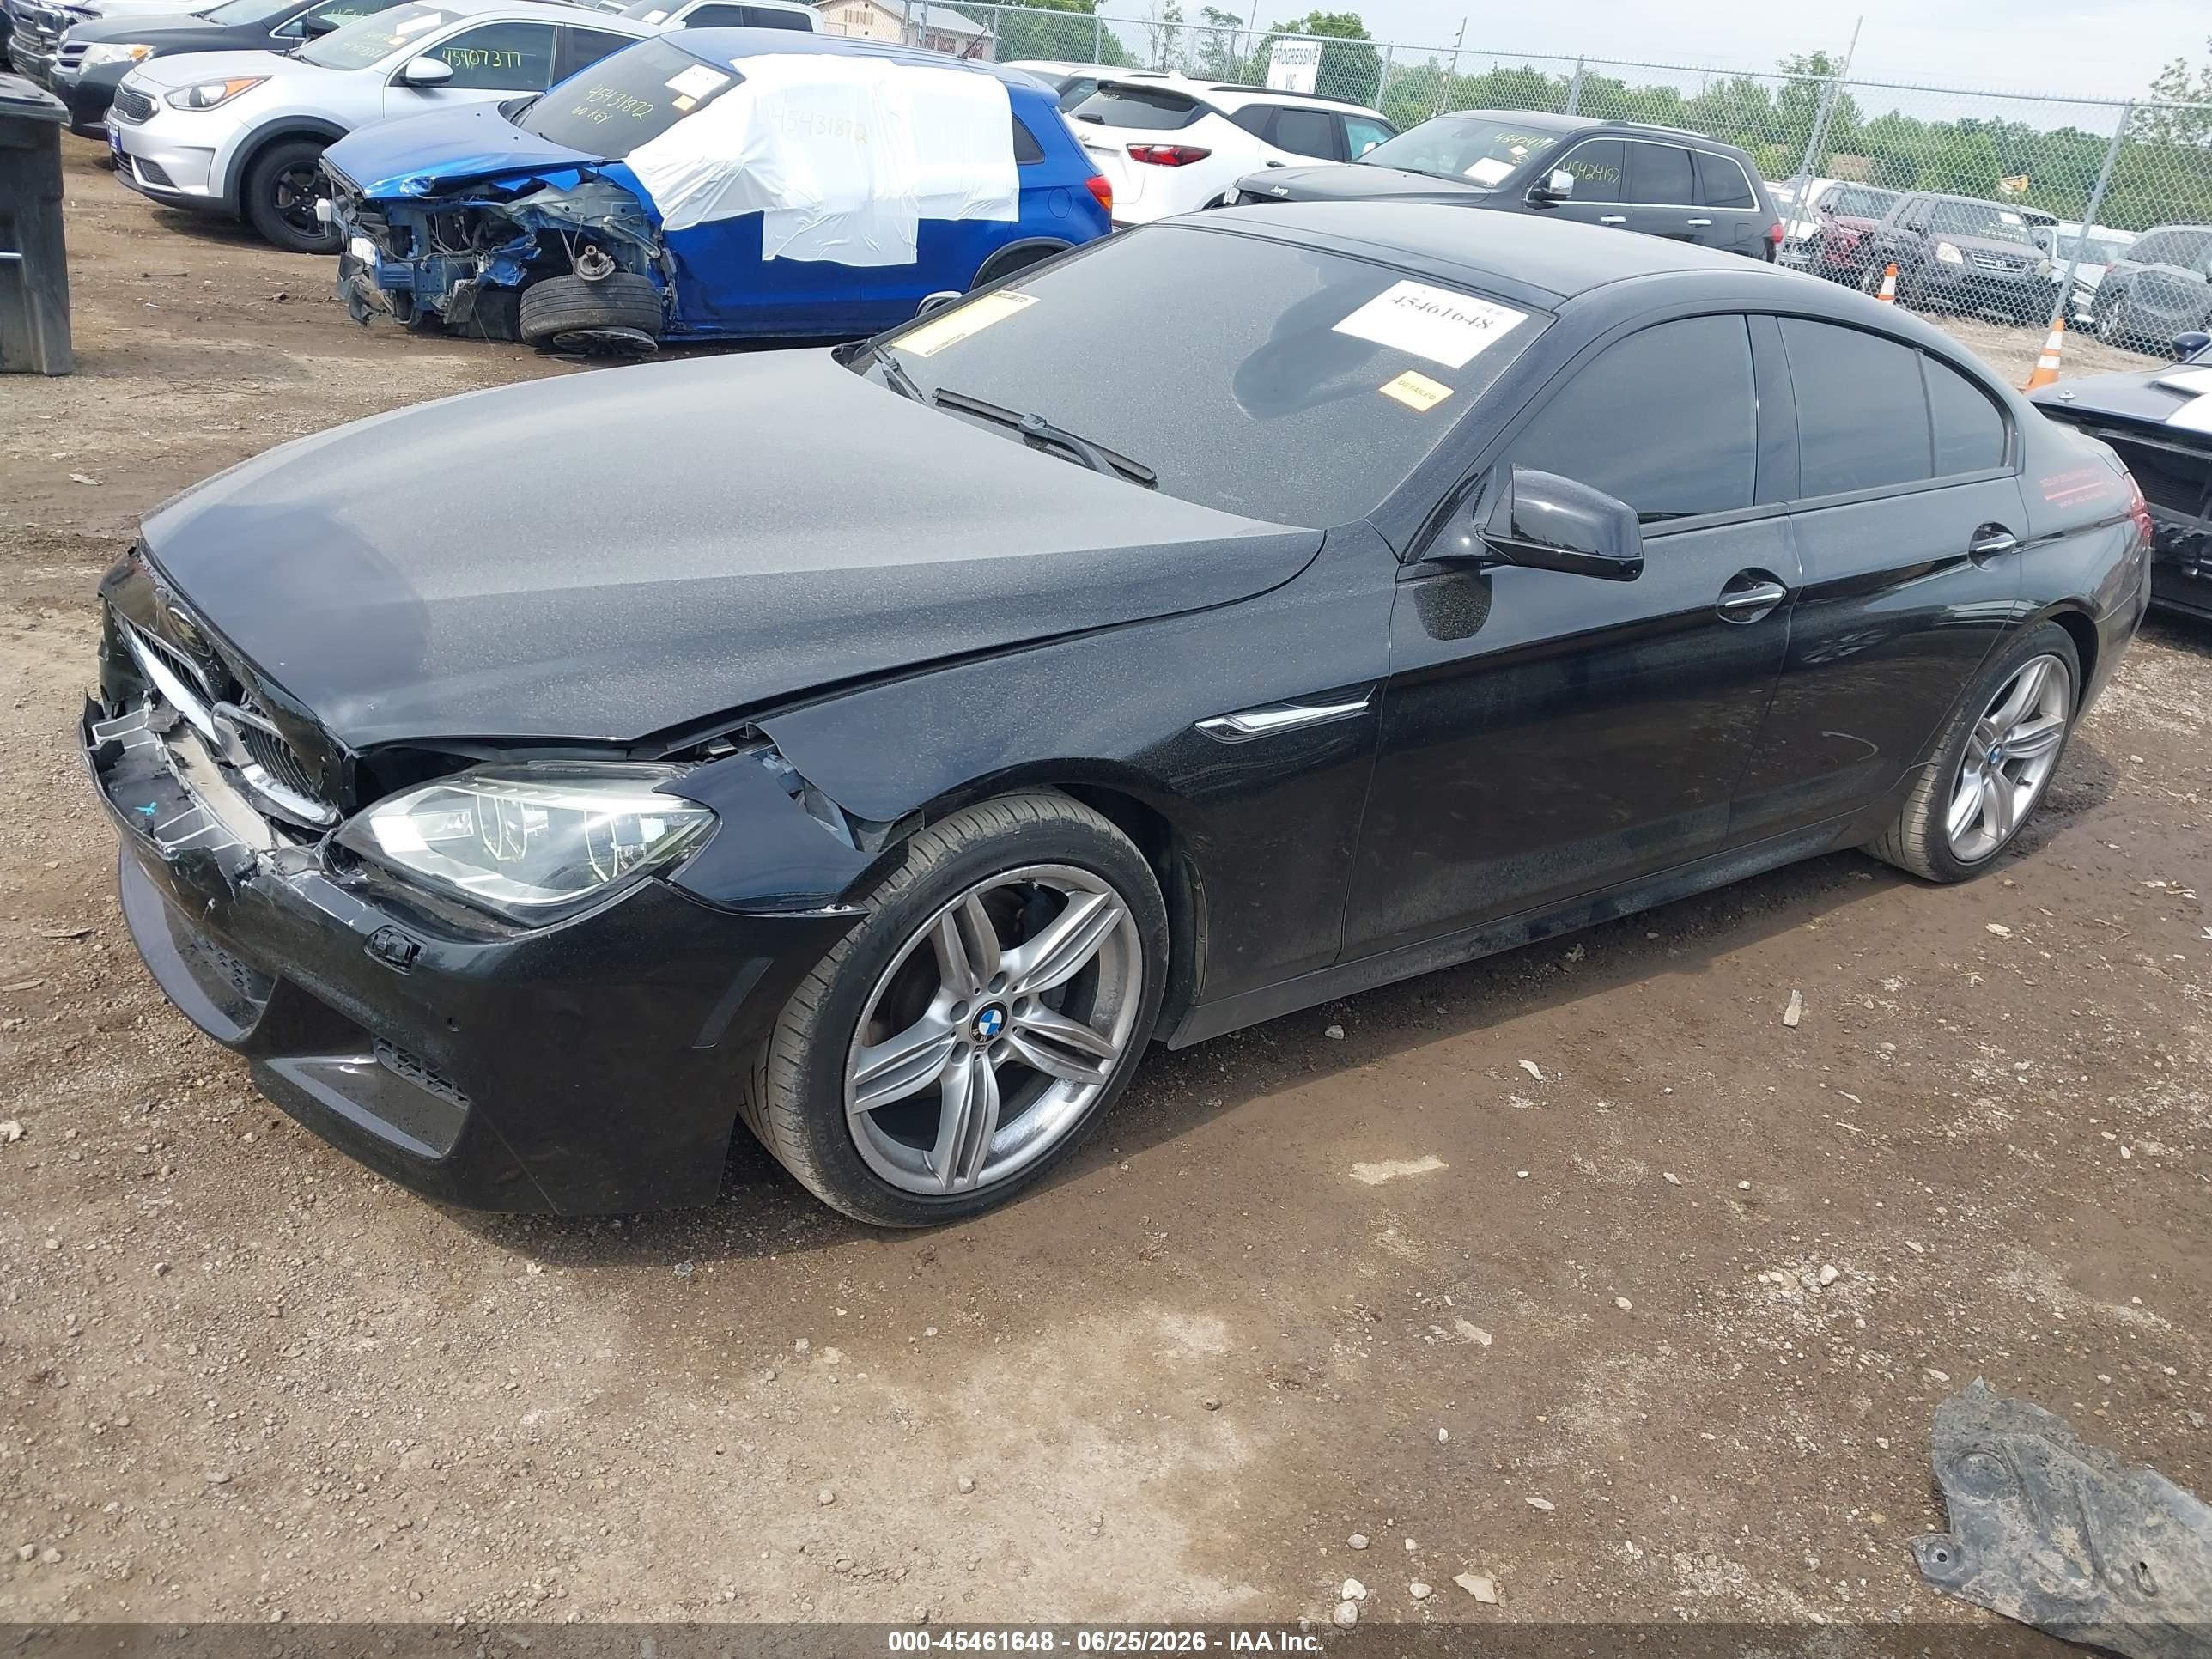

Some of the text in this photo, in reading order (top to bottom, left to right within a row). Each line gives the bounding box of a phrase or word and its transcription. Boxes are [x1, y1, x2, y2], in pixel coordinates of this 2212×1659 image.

[441, 50, 521, 70] 45407377
[1273, 48, 1319, 65] PROGRESSIVE
[1271, 185, 1288, 196] Jeep
[1392, 296, 1494, 329] 45461648
[1397, 380, 1437, 400] DETAILED
